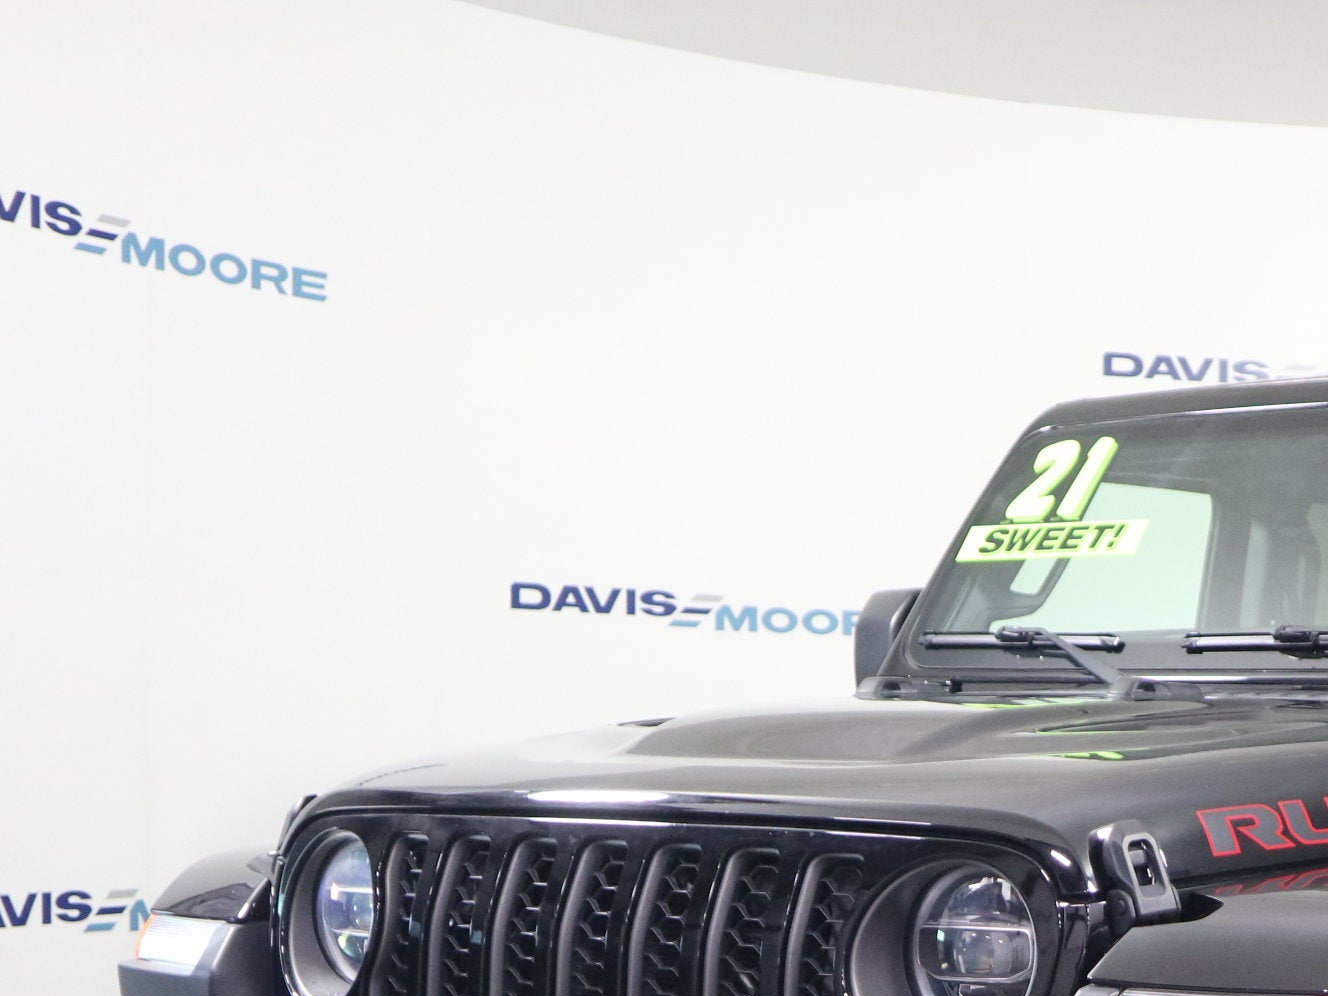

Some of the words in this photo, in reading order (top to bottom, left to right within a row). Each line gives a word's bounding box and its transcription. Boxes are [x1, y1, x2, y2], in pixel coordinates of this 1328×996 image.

[121, 232, 328, 302] MOORE
[1103, 351, 1269, 382] DAVIS
[1005, 436, 1119, 523] 21
[977, 521, 1126, 555] SWEET!
[510, 582, 676, 616] DAVIS
[0, 890, 92, 928] VIS
